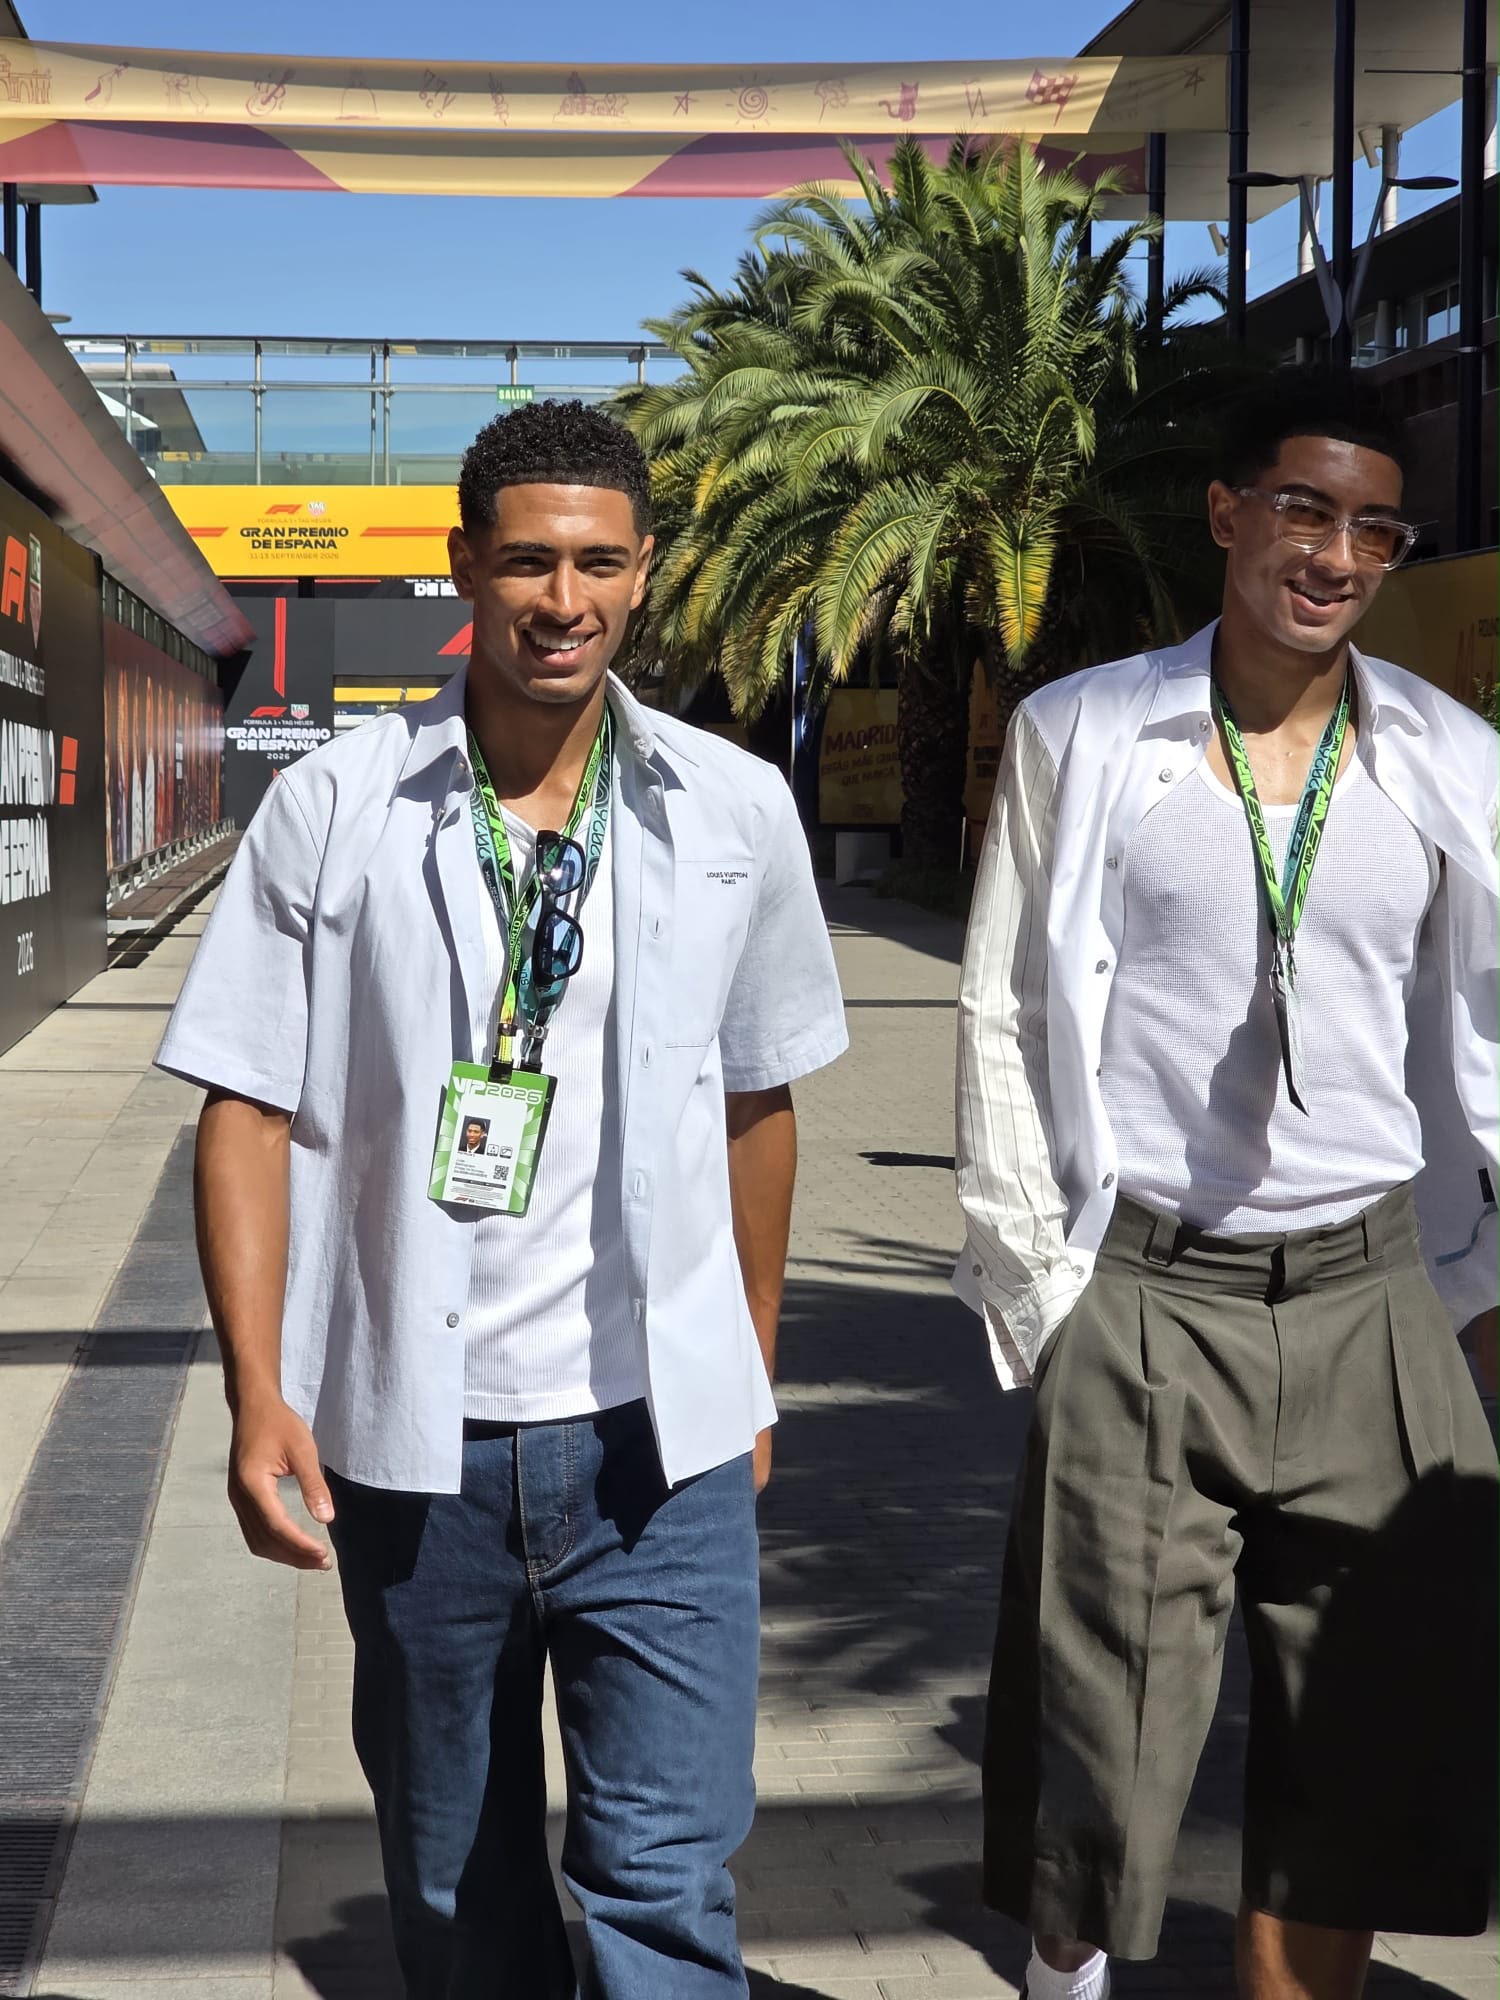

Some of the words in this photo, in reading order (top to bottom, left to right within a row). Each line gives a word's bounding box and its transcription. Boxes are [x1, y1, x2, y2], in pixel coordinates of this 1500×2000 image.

[498, 389, 533, 400] SALIDA
[240, 527, 285, 537] GRAN
[289, 527, 349, 537] PREMIO
[252, 540, 271, 549] DE
[226, 727, 271, 739] GRAN
[272, 728, 331, 740] PREMIO
[237, 739, 257, 750] DE
[266, 752, 290, 760] 2026
[1254, 818, 1265, 839] VIP
[1303, 846, 1314, 865] VIP
[18, 931, 34, 976] 2026
